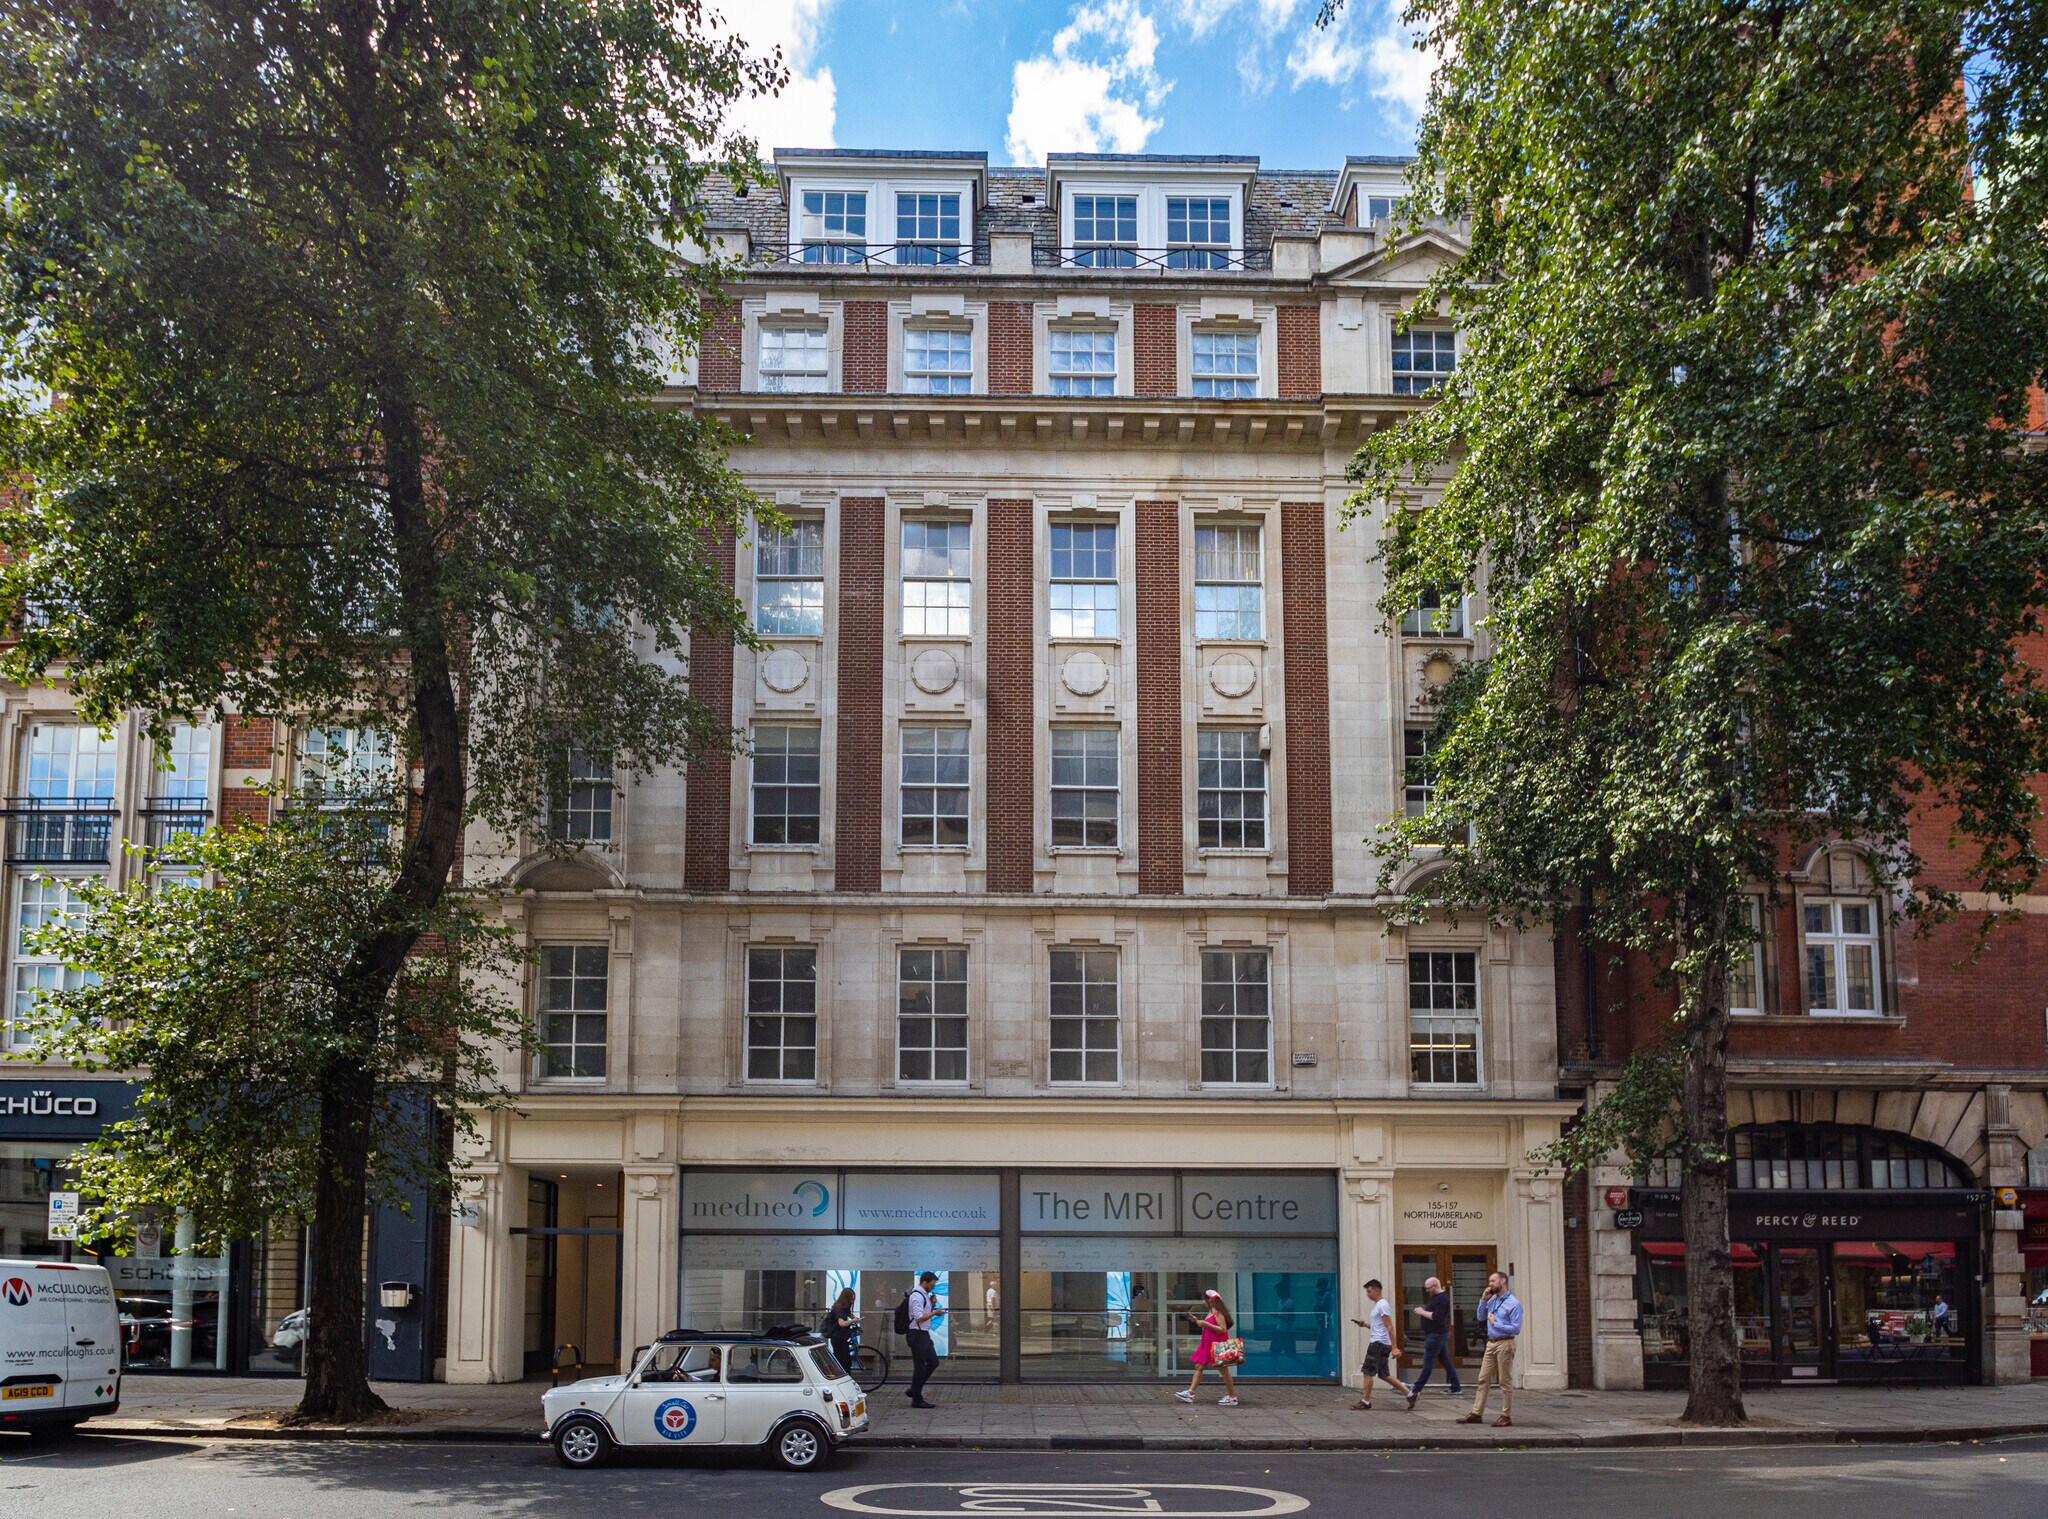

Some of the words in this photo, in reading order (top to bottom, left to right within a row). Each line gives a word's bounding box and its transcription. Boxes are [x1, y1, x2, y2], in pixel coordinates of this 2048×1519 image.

[691, 1194, 803, 1218] medneo
[858, 1205, 988, 1220] www.medneo.co.uk
[1032, 1192, 1090, 1220] The
[1104, 1192, 1163, 1220] MRI
[1192, 1192, 1299, 1220] Centre
[1428, 1202, 1459, 1210] 155-157
[1404, 1211, 1483, 1219] NORTHUMBERLAND
[1756, 1215, 1799, 1226] PERCY
[1802, 1213, 1817, 1228] &
[1822, 1215, 1859, 1226] REED
[1430, 1221, 1458, 1229] HOUSE
[37, 1283, 110, 1296] McCULLOUGHS
[6, 1345, 115, 1359] www.mcculloughs.co.uk
[8, 1388, 28, 1397] AG19
